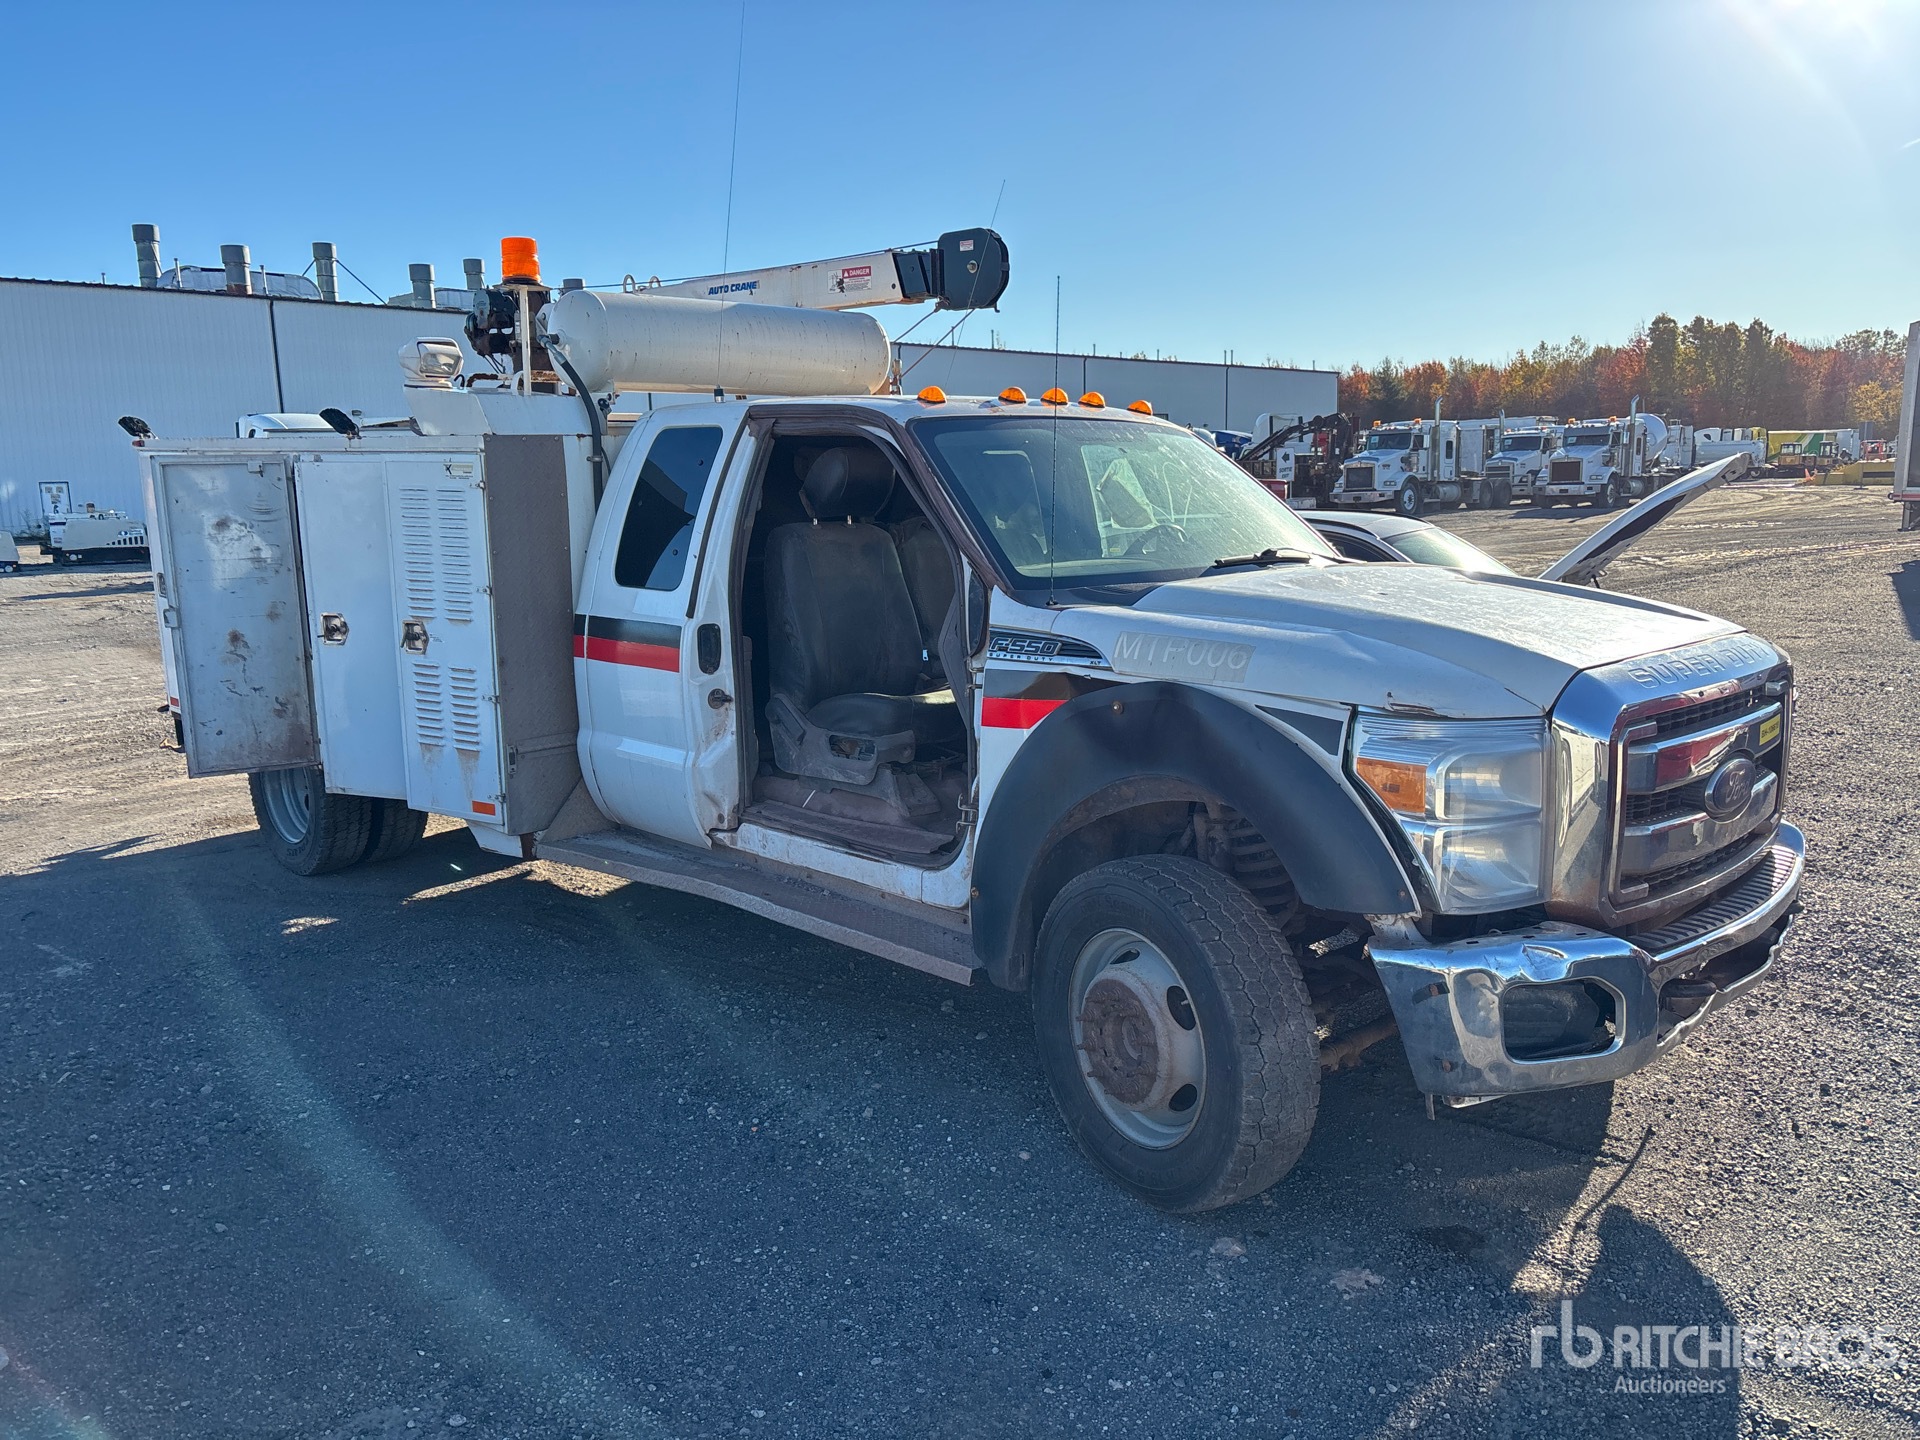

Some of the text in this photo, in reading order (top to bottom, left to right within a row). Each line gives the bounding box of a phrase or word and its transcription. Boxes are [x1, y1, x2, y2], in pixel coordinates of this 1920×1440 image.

[849, 268, 870, 276] DANGER
[708, 281, 757, 295] AUTO CRANE
[989, 652, 1021, 660] SUPER
[1113, 630, 1249, 670] MTP006
[1628, 642, 1770, 689] SUPER DUTY
[1725, 769, 1750, 803] Ford
